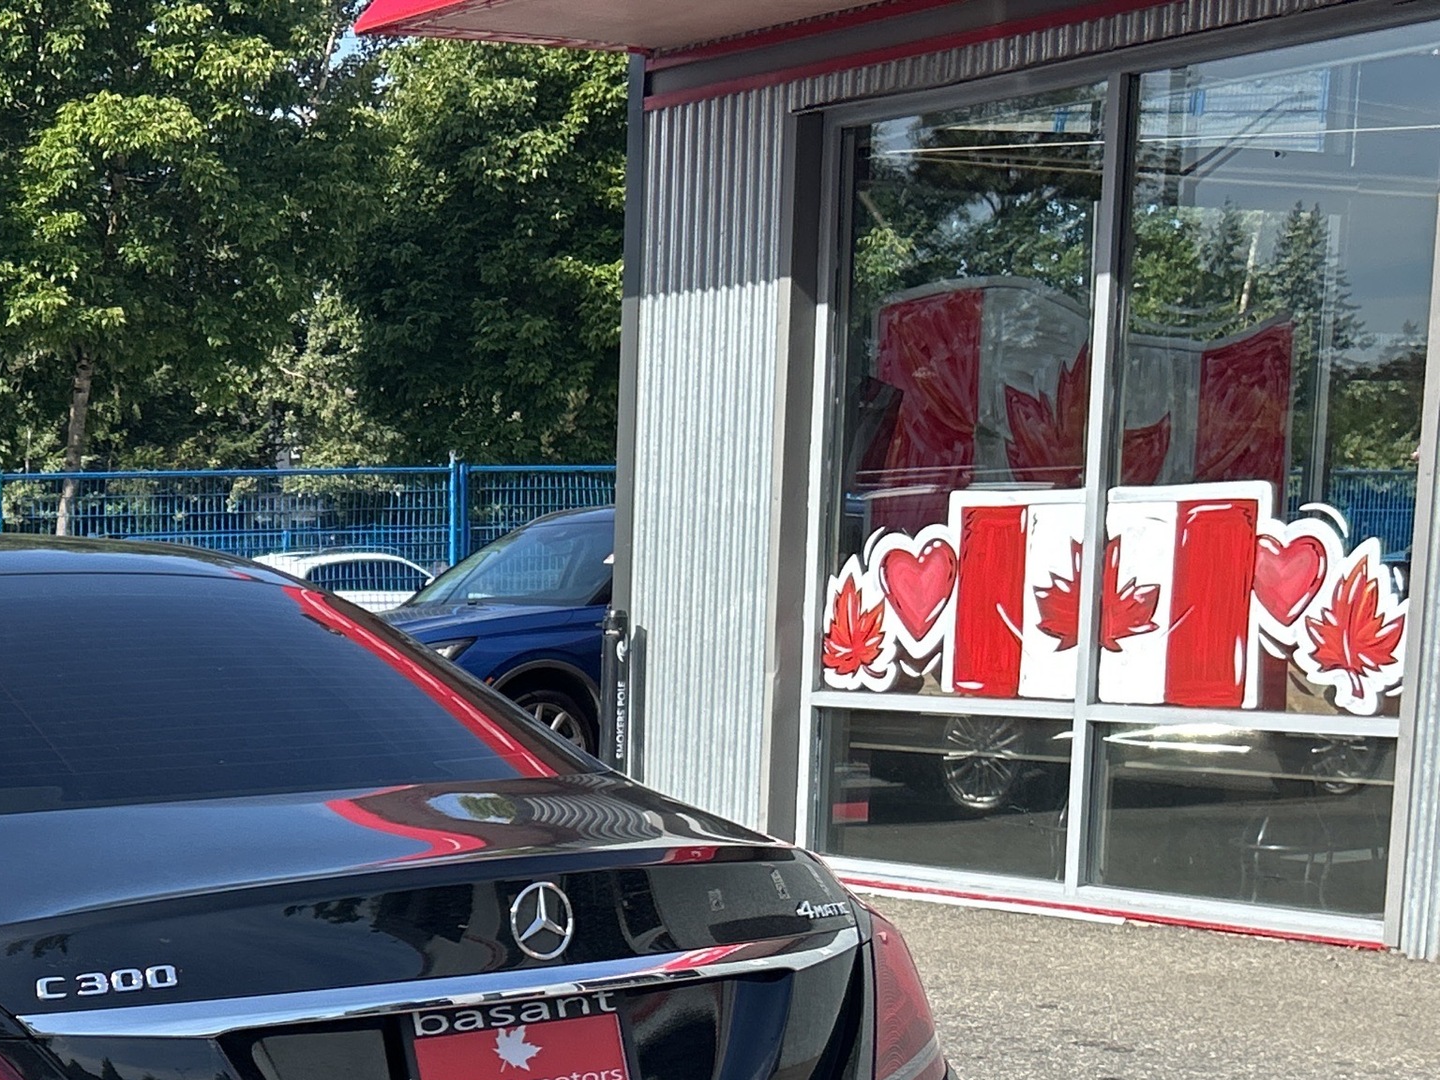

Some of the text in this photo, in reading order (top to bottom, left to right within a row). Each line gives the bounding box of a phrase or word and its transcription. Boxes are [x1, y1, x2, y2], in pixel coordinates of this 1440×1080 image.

[615, 681, 626, 759] SMOKERS POLE
[796, 901, 850, 918] 4MATIC
[36, 964, 178, 1000] C 300
[414, 991, 617, 1036] basant
